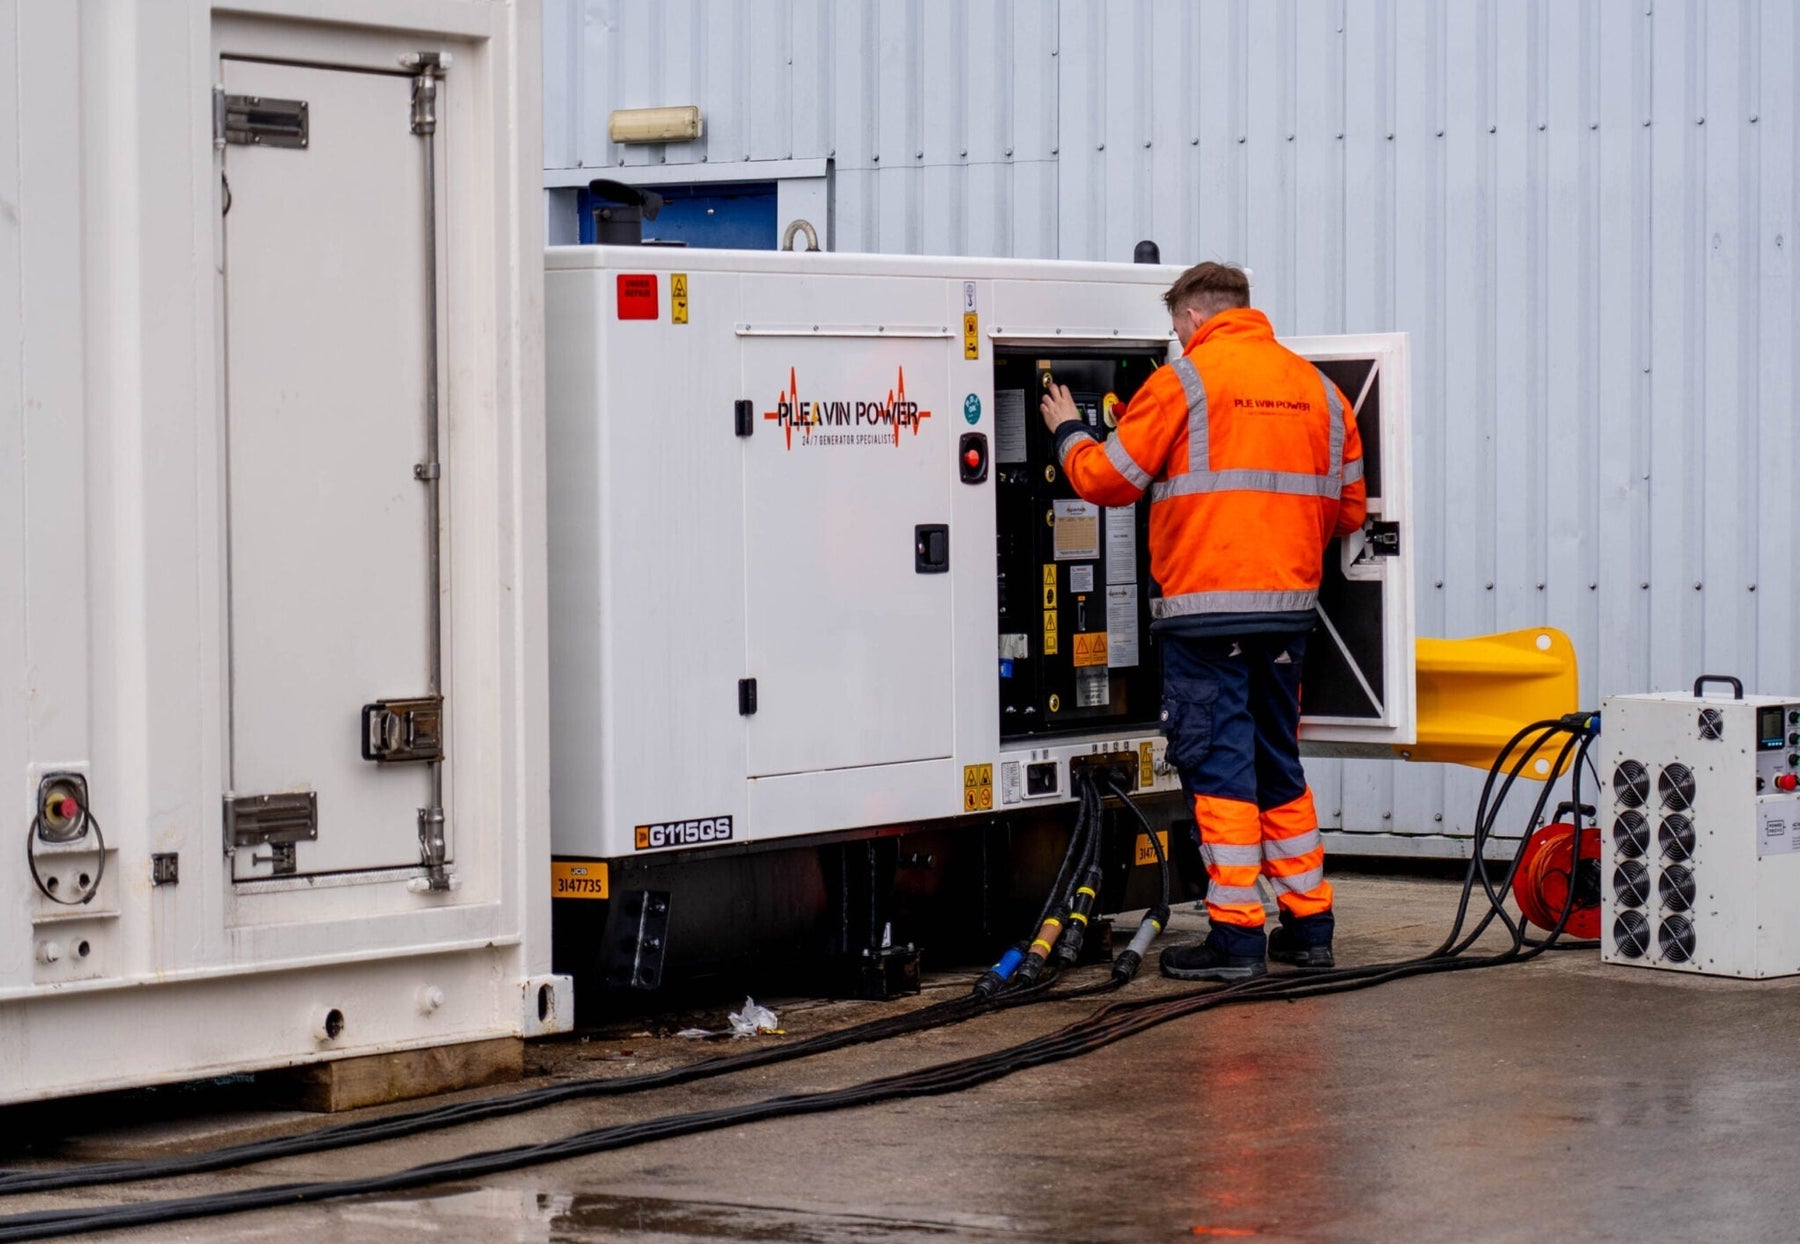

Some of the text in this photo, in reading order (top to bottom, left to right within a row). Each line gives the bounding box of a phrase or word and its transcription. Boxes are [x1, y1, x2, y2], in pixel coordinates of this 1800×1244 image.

[1276, 400, 1310, 411] POWER
[778, 401, 918, 426] PLEAVIN POWER
[802, 434, 895, 445] 24/7 GENERATOR SPECIALISTS
[649, 818, 730, 846] G115QS
[558, 878, 602, 892] 3147735
